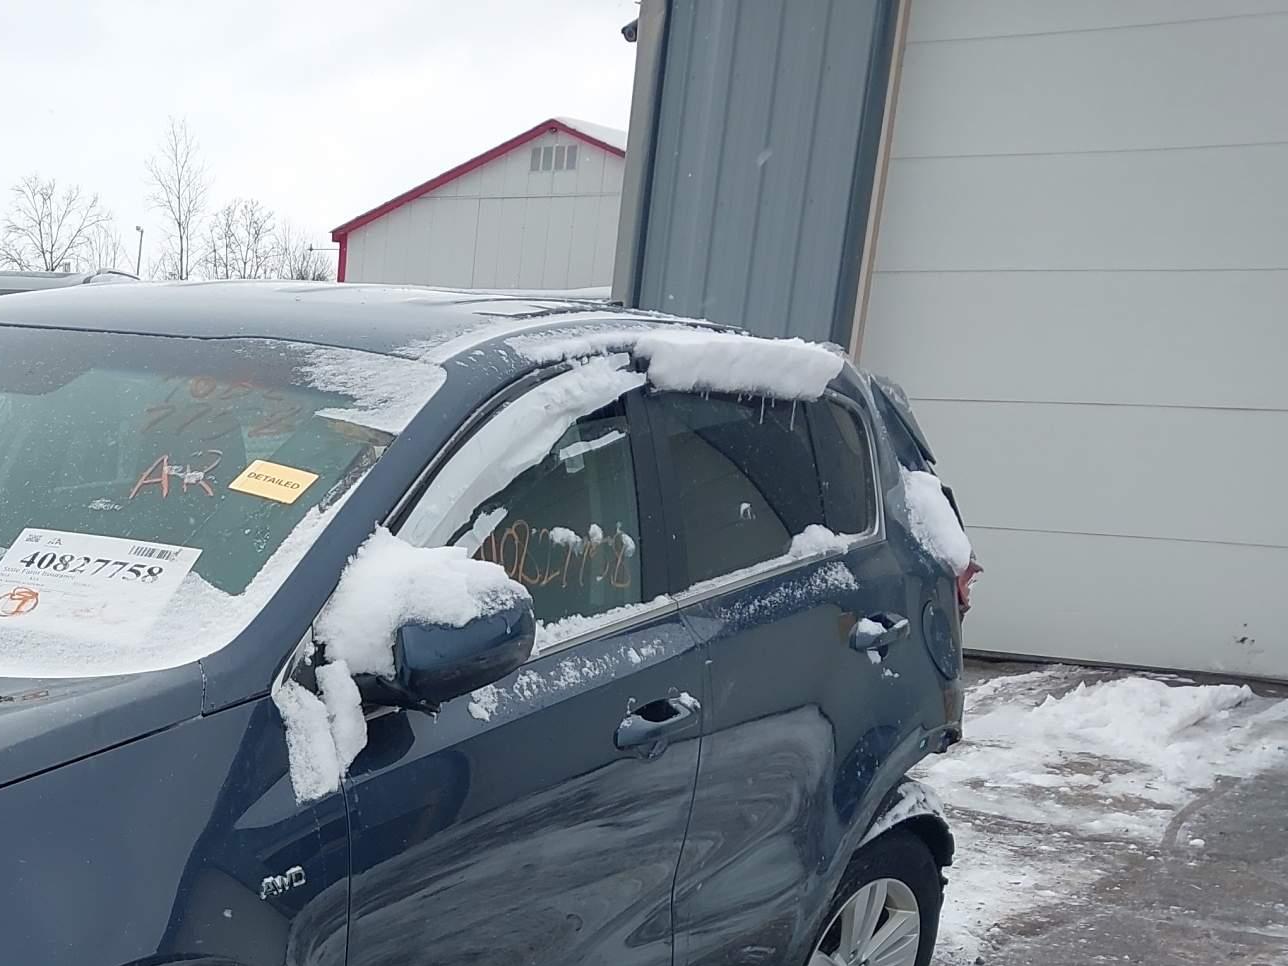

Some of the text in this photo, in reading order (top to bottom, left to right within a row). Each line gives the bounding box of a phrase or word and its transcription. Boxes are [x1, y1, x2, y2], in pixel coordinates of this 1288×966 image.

[247, 470, 301, 490] DETAILED
[20, 551, 164, 584] 40827758
[260, 865, 307, 900] AWD
